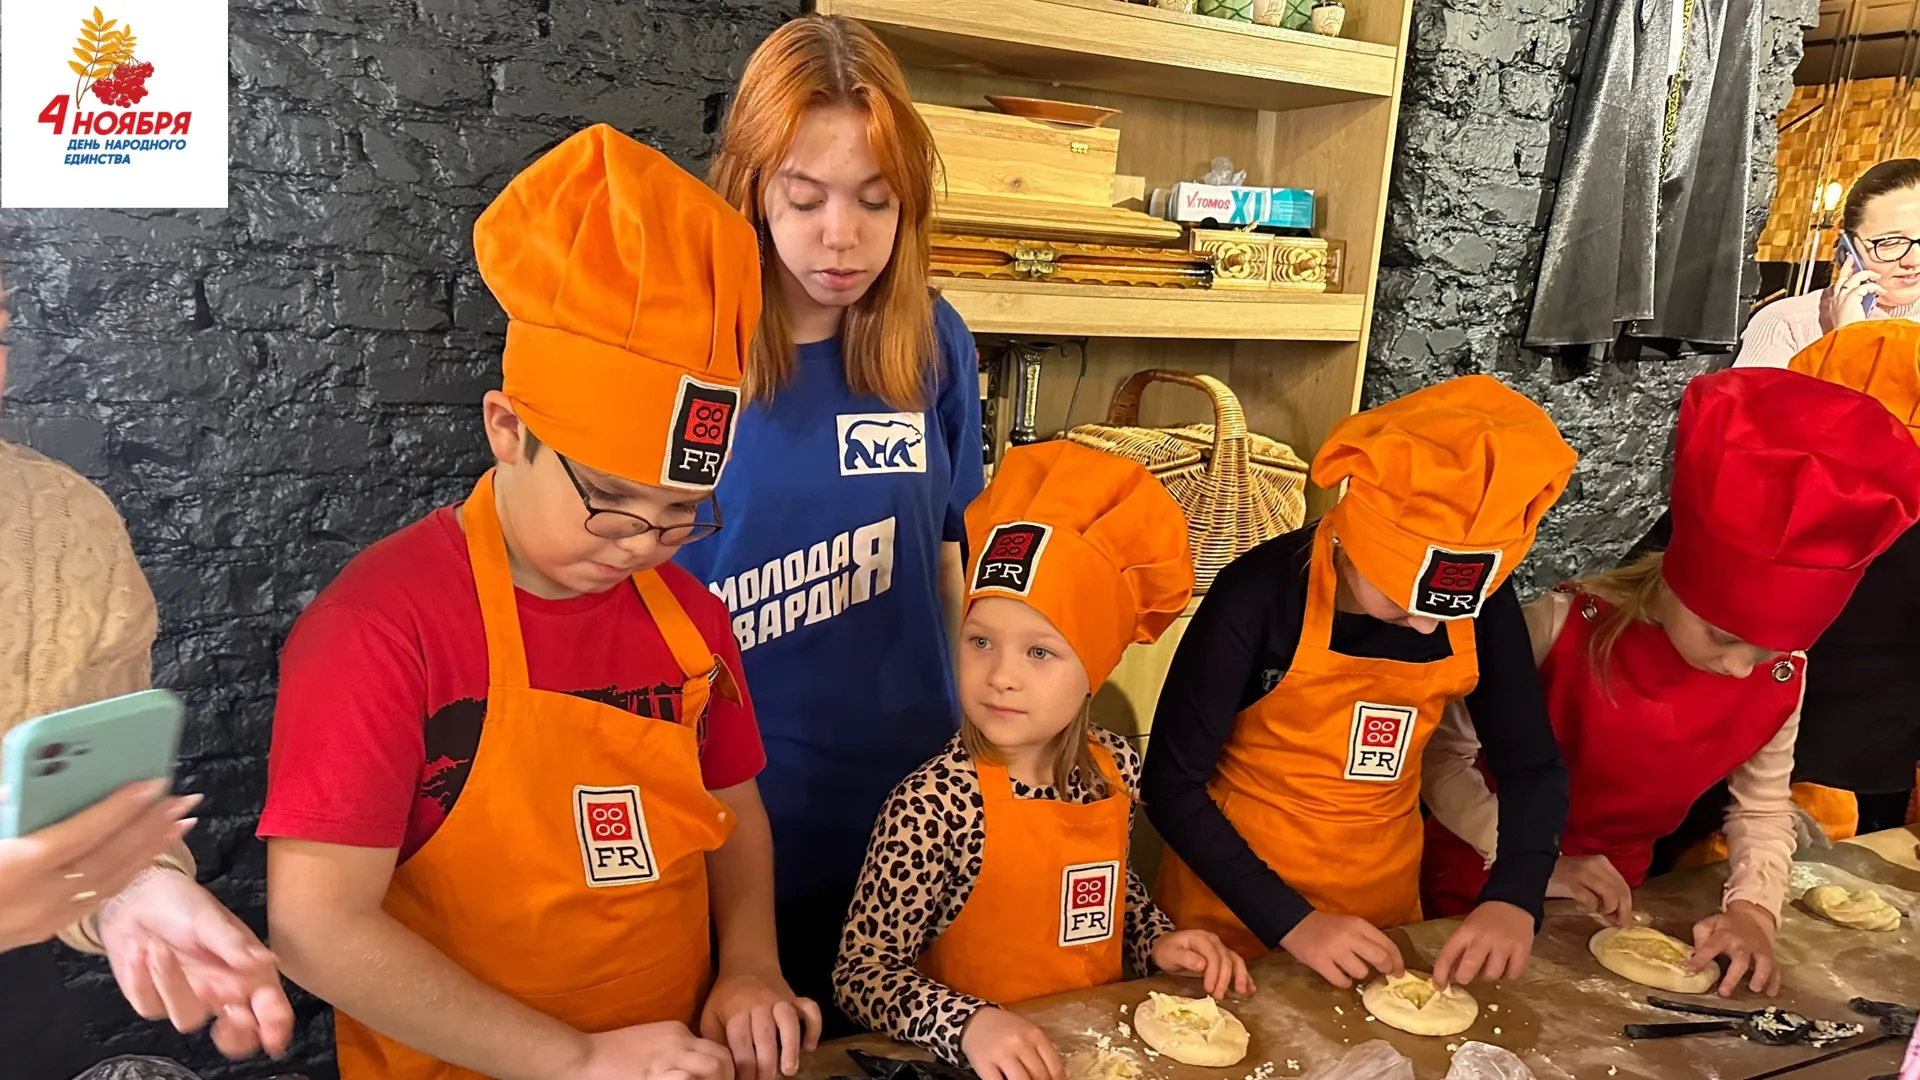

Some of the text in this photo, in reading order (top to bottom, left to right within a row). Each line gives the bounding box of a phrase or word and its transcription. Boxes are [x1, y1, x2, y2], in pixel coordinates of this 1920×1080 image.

[679, 447, 720, 477] FR
[708, 516, 896, 613] МОЛОДАЯ
[982, 562, 1023, 585] FR
[1425, 590, 1474, 610] FR
[1358, 750, 1395, 772] FR
[594, 846, 645, 870] FR
[1071, 911, 1106, 931] FR
